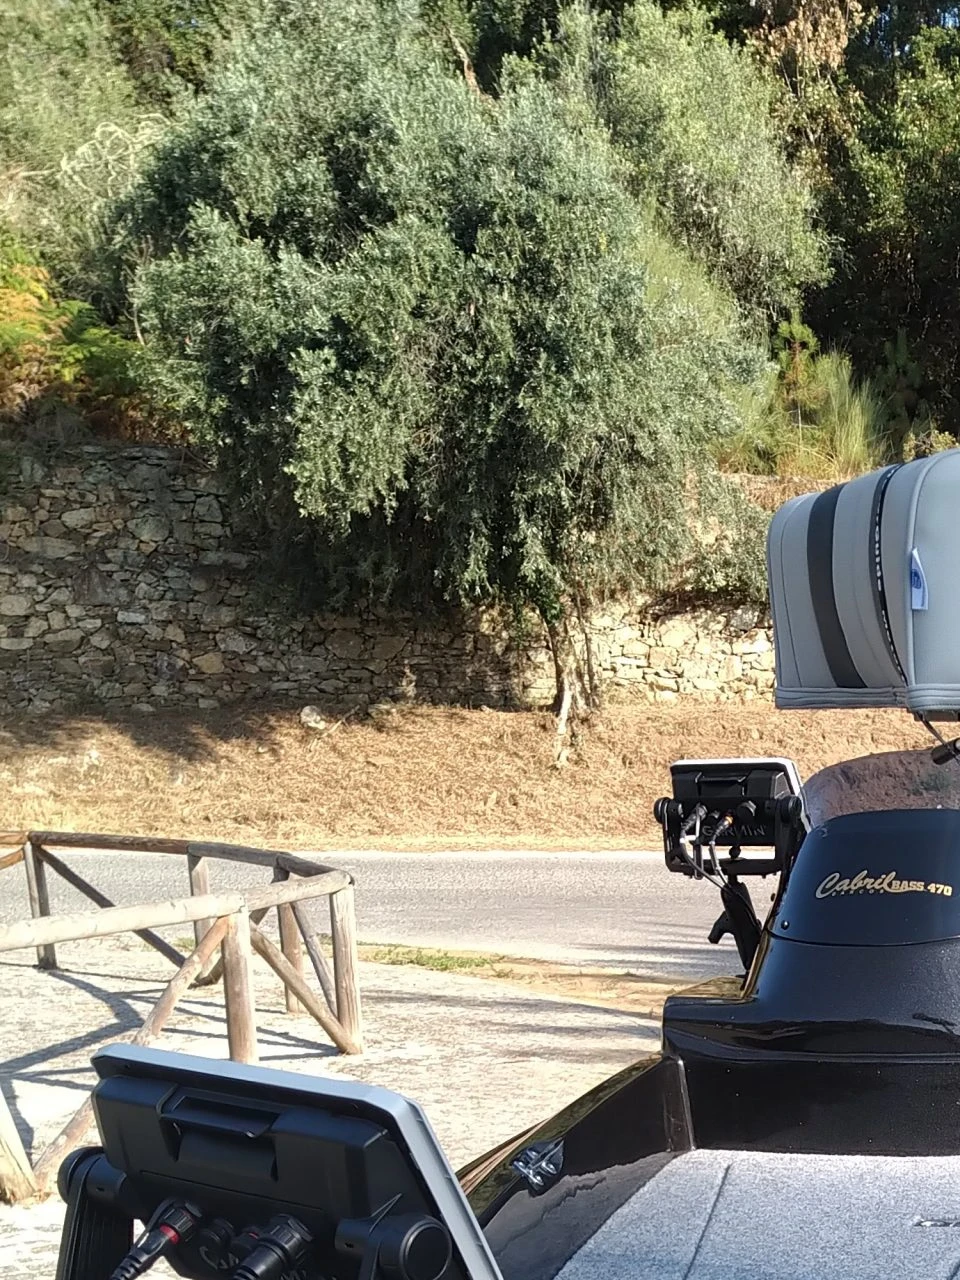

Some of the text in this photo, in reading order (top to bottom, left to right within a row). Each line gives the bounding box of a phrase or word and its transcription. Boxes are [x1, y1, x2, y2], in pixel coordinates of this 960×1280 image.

[702, 825, 767, 837] GRMIN
[816, 869, 953, 899] Cabril BASS 470
